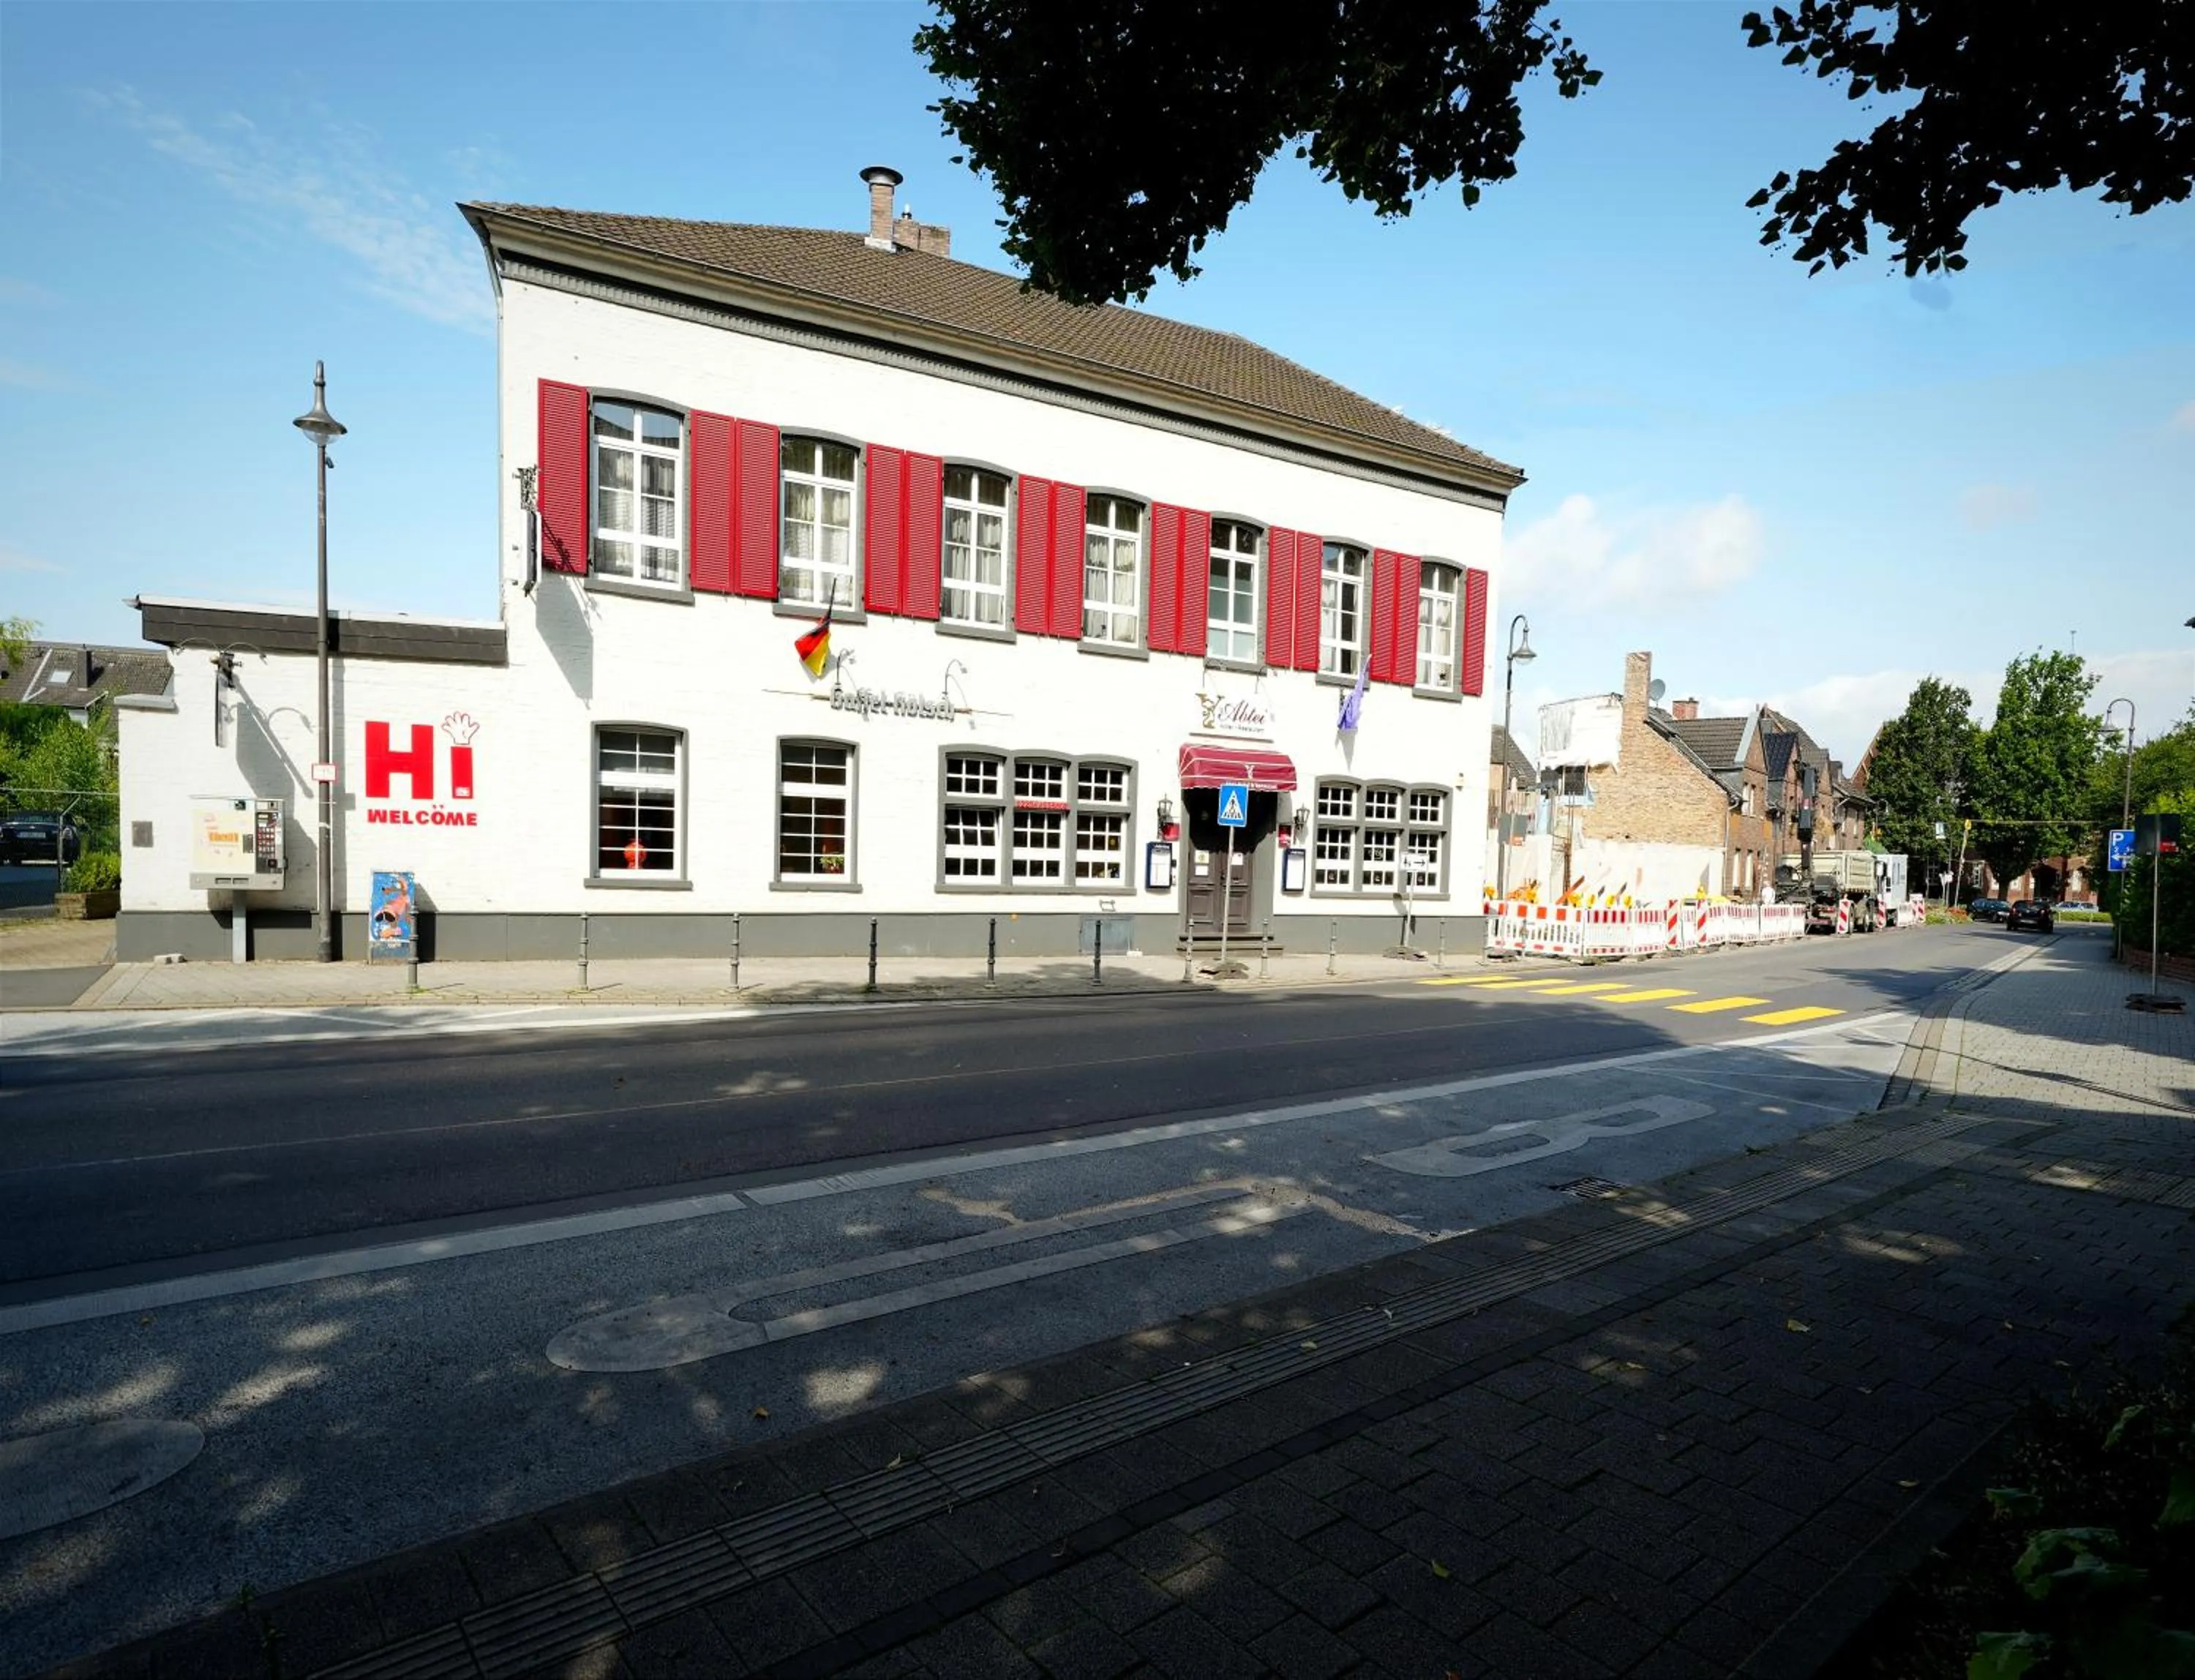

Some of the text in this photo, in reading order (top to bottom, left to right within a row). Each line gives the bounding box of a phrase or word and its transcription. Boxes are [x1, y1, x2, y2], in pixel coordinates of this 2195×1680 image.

[1217, 700, 1267, 724] Abtei
[367, 804, 478, 827] WELCÖME
[2112, 832, 2124, 847] P
